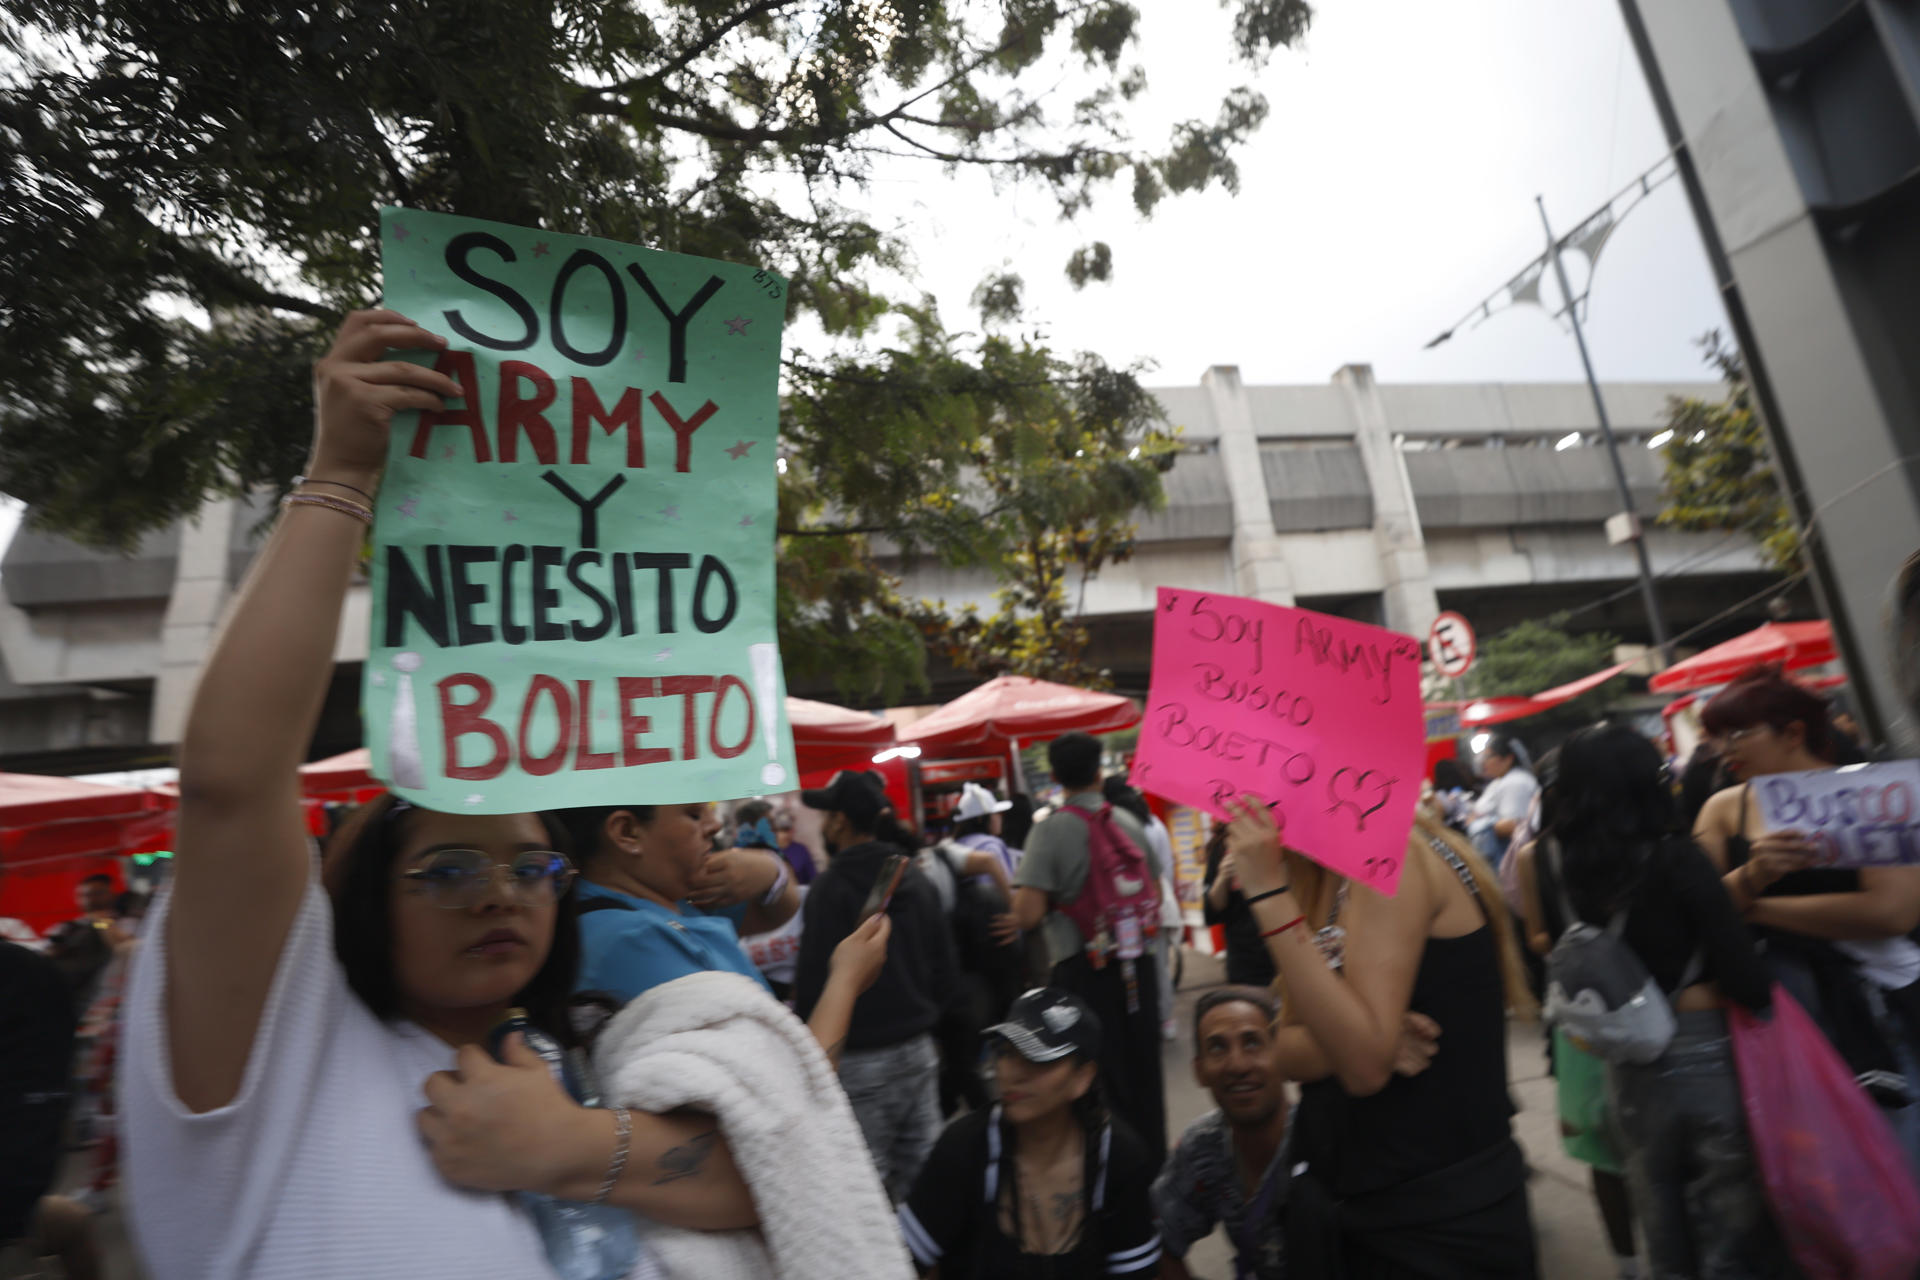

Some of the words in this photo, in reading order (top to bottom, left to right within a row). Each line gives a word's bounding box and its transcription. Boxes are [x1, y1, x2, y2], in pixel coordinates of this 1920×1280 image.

[442, 231, 727, 383] SOY
[752, 269, 783, 299] BTS
[409, 349, 720, 473] ARMY
[540, 470, 628, 549] Y
[384, 543, 737, 648] NECESITO
[1436, 624, 1463, 665] E
